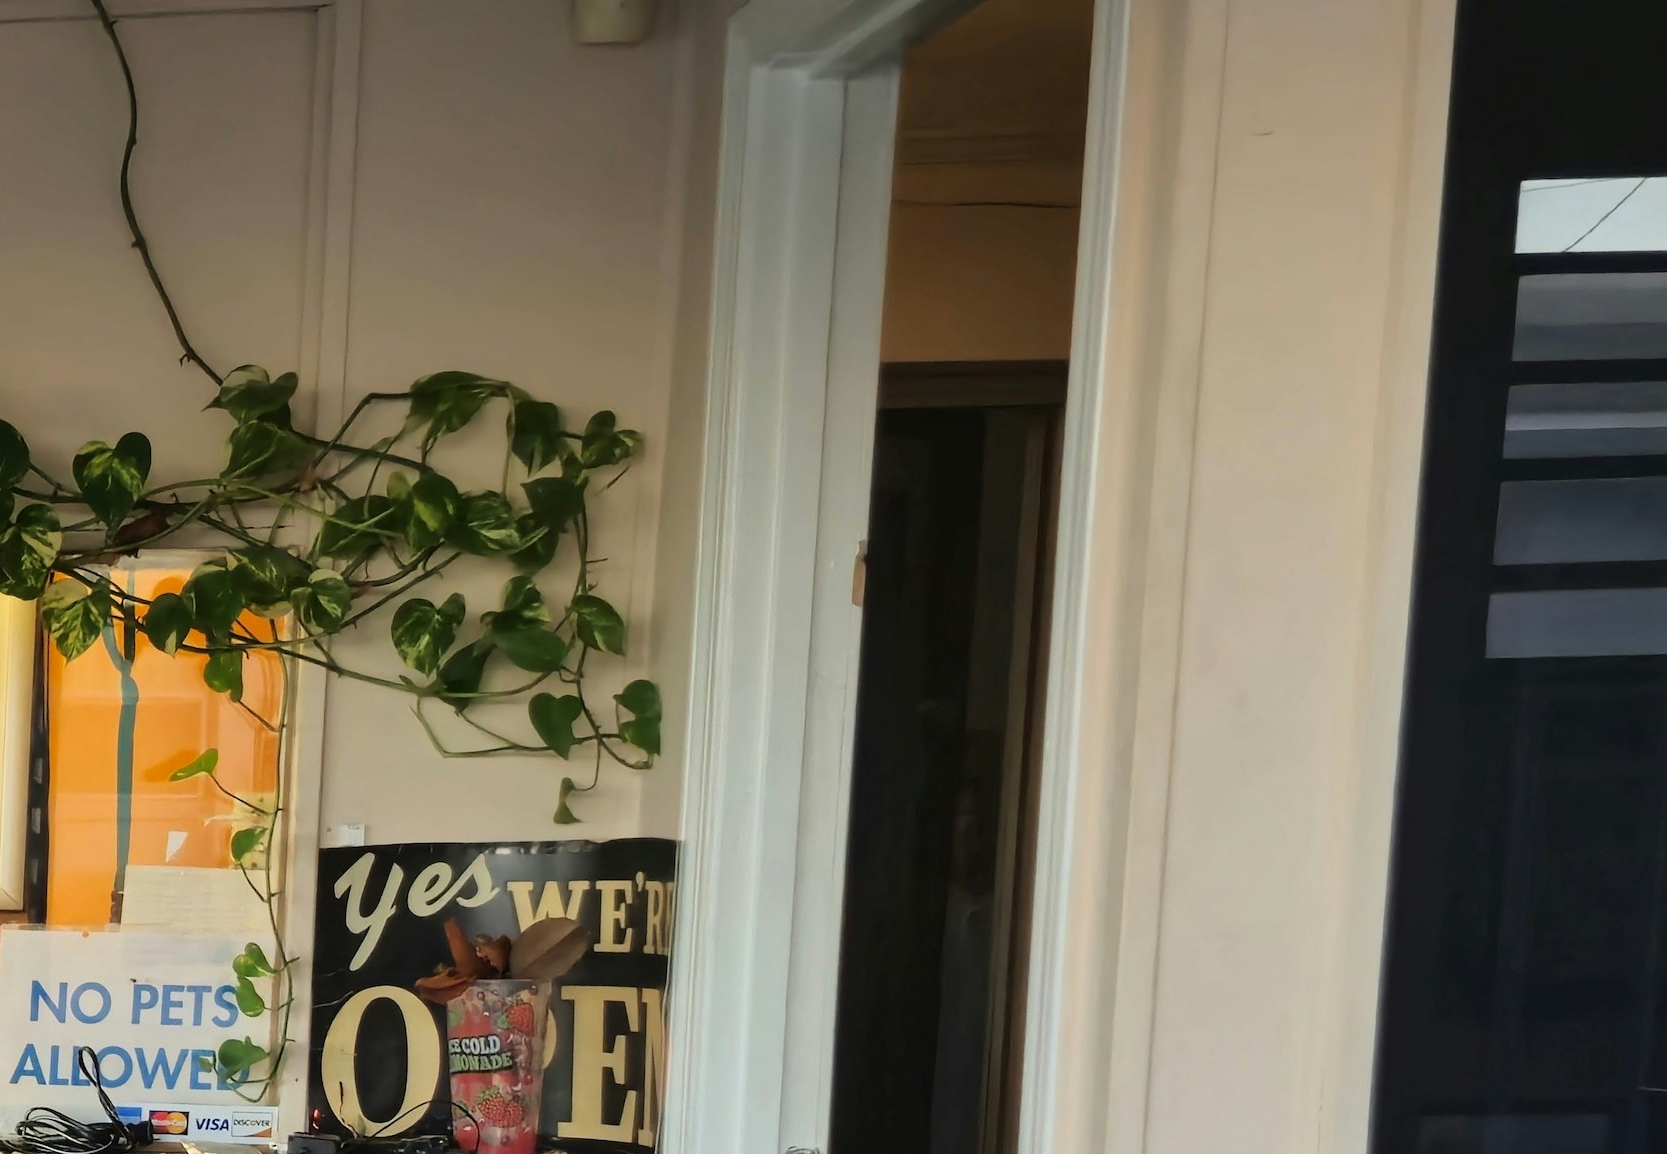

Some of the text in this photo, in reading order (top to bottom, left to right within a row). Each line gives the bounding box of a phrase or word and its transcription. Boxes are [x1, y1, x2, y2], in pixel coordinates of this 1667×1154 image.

[29, 980, 240, 1028] NO PETS
[461, 1035, 501, 1055] COLD
[196, 1118, 229, 1131] VISA
[233, 1118, 271, 1127] DISCOVER
